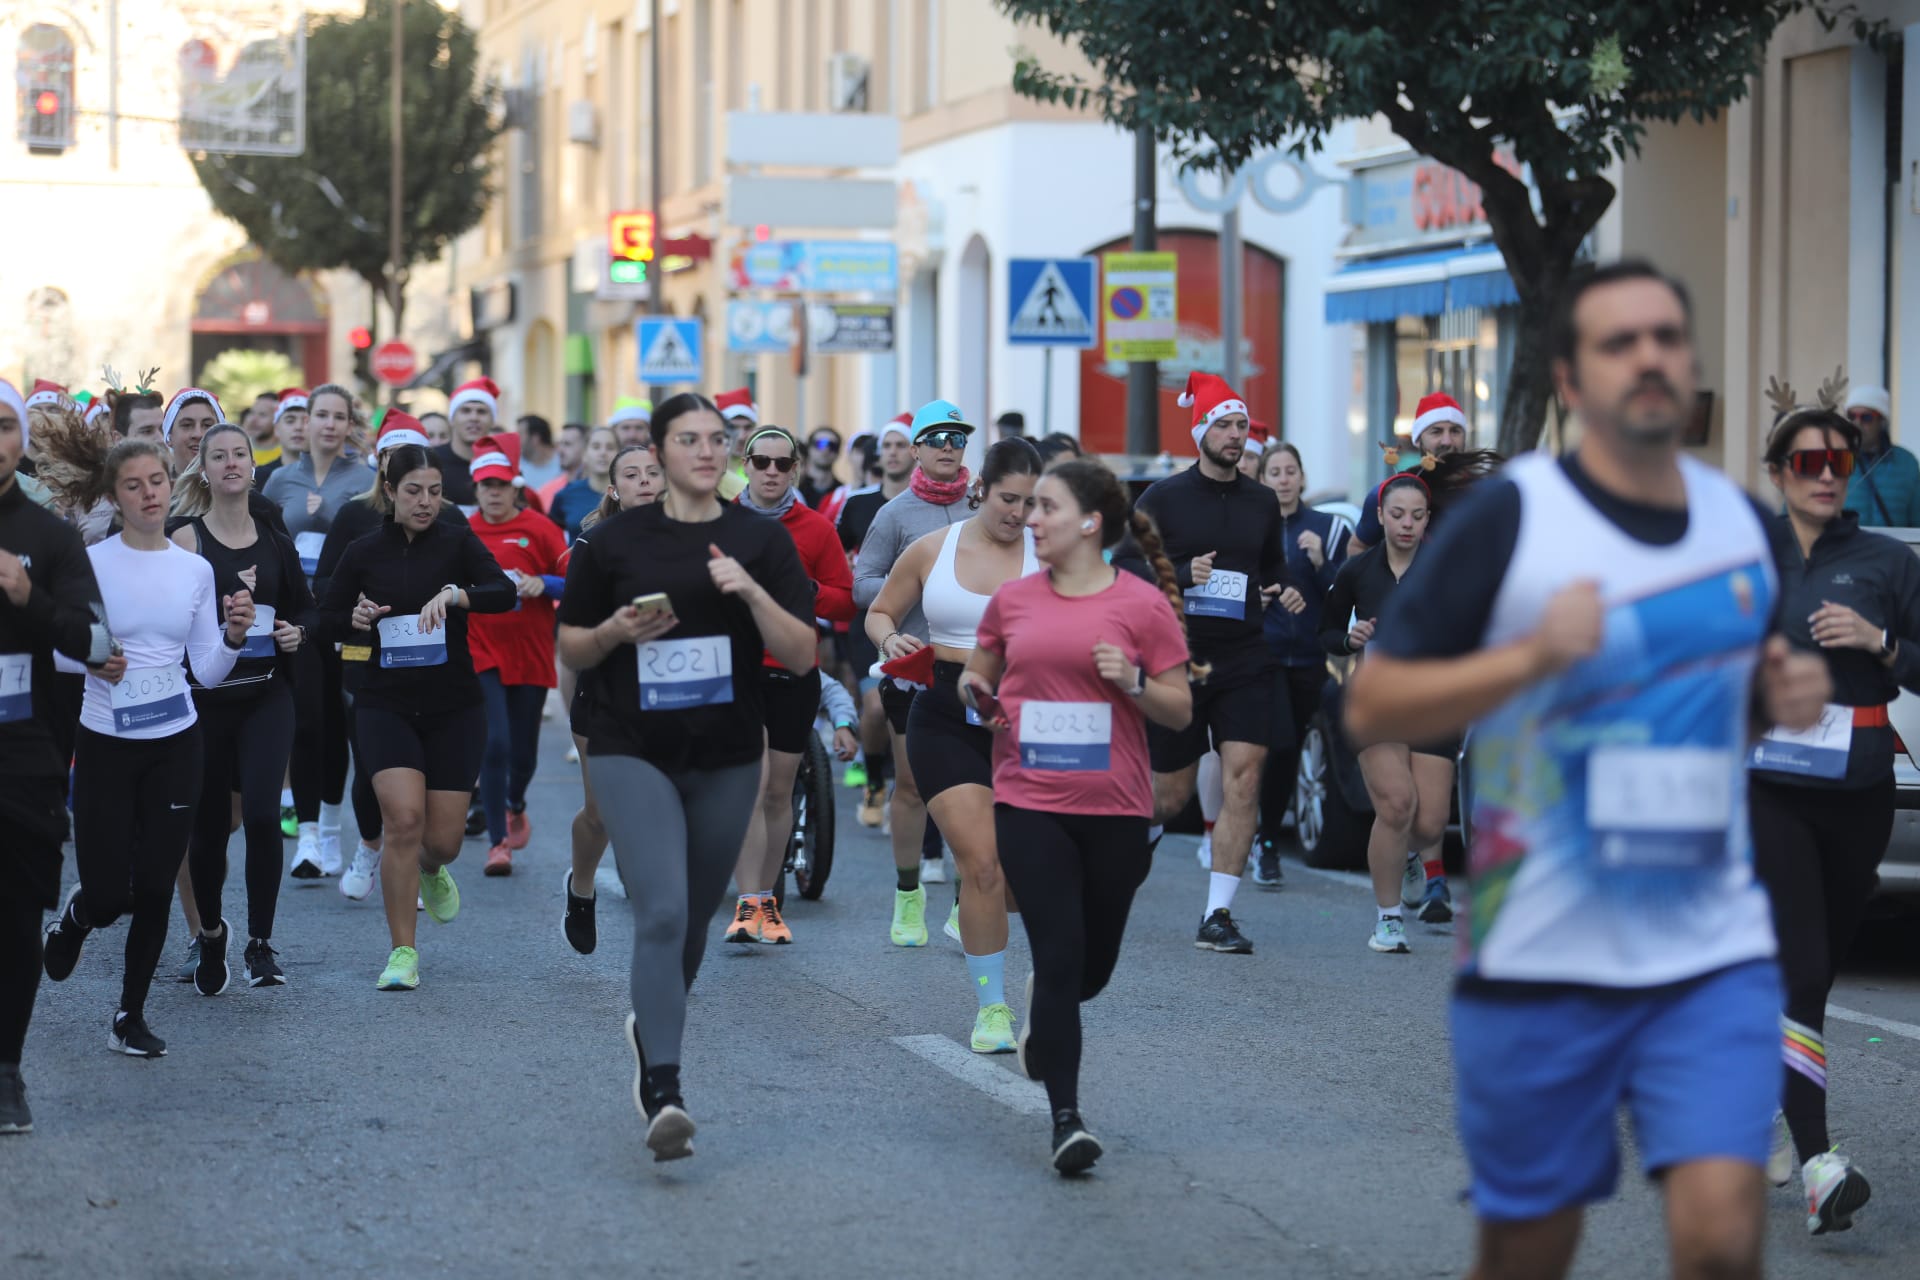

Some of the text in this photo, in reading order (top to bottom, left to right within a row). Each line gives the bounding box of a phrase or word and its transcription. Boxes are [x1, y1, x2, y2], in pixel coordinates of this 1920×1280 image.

[647, 645, 720, 678] 2021
[123, 672, 175, 699] 2033
[1033, 711, 1100, 734] 2022
